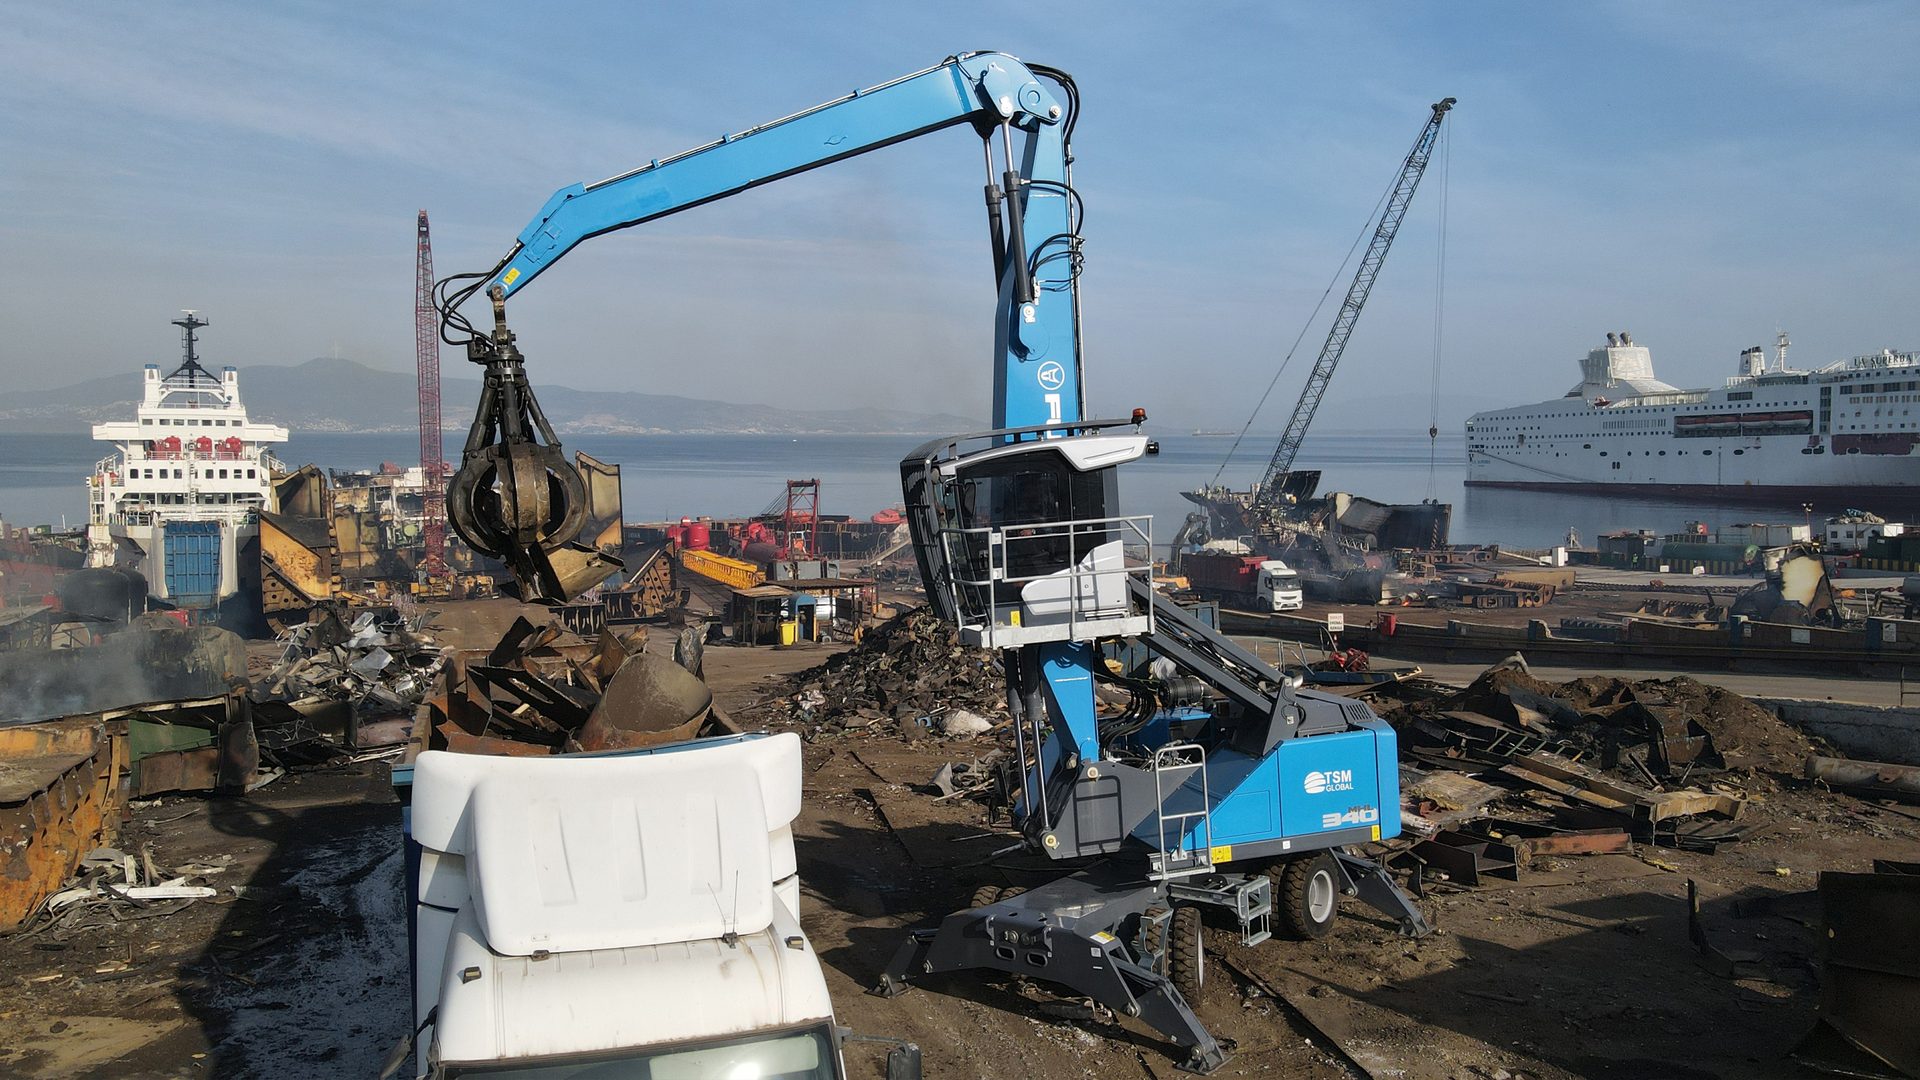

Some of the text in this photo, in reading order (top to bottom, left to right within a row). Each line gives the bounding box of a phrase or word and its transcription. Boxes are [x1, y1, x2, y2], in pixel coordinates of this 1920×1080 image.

[1854, 354, 1912, 368] LA SUPERBA
[1323, 769, 1352, 785] TSM
[1325, 783, 1354, 792] GLOBAL
[1322, 808, 1378, 828] 340
